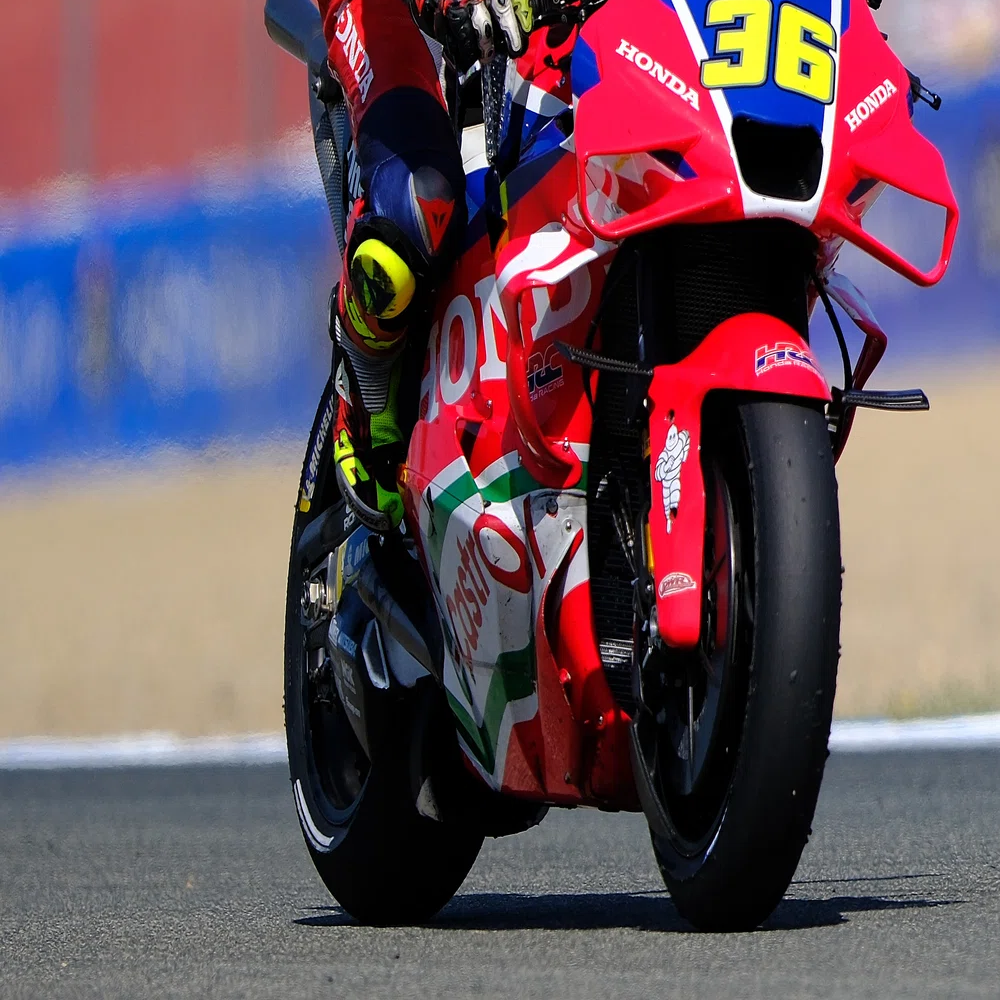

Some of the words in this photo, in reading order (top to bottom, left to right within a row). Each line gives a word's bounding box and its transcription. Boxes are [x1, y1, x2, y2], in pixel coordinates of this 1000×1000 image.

[616, 38, 701, 111] HONDA
[843, 77, 898, 133] HONDA
[308, 396, 335, 474] MICHELI
